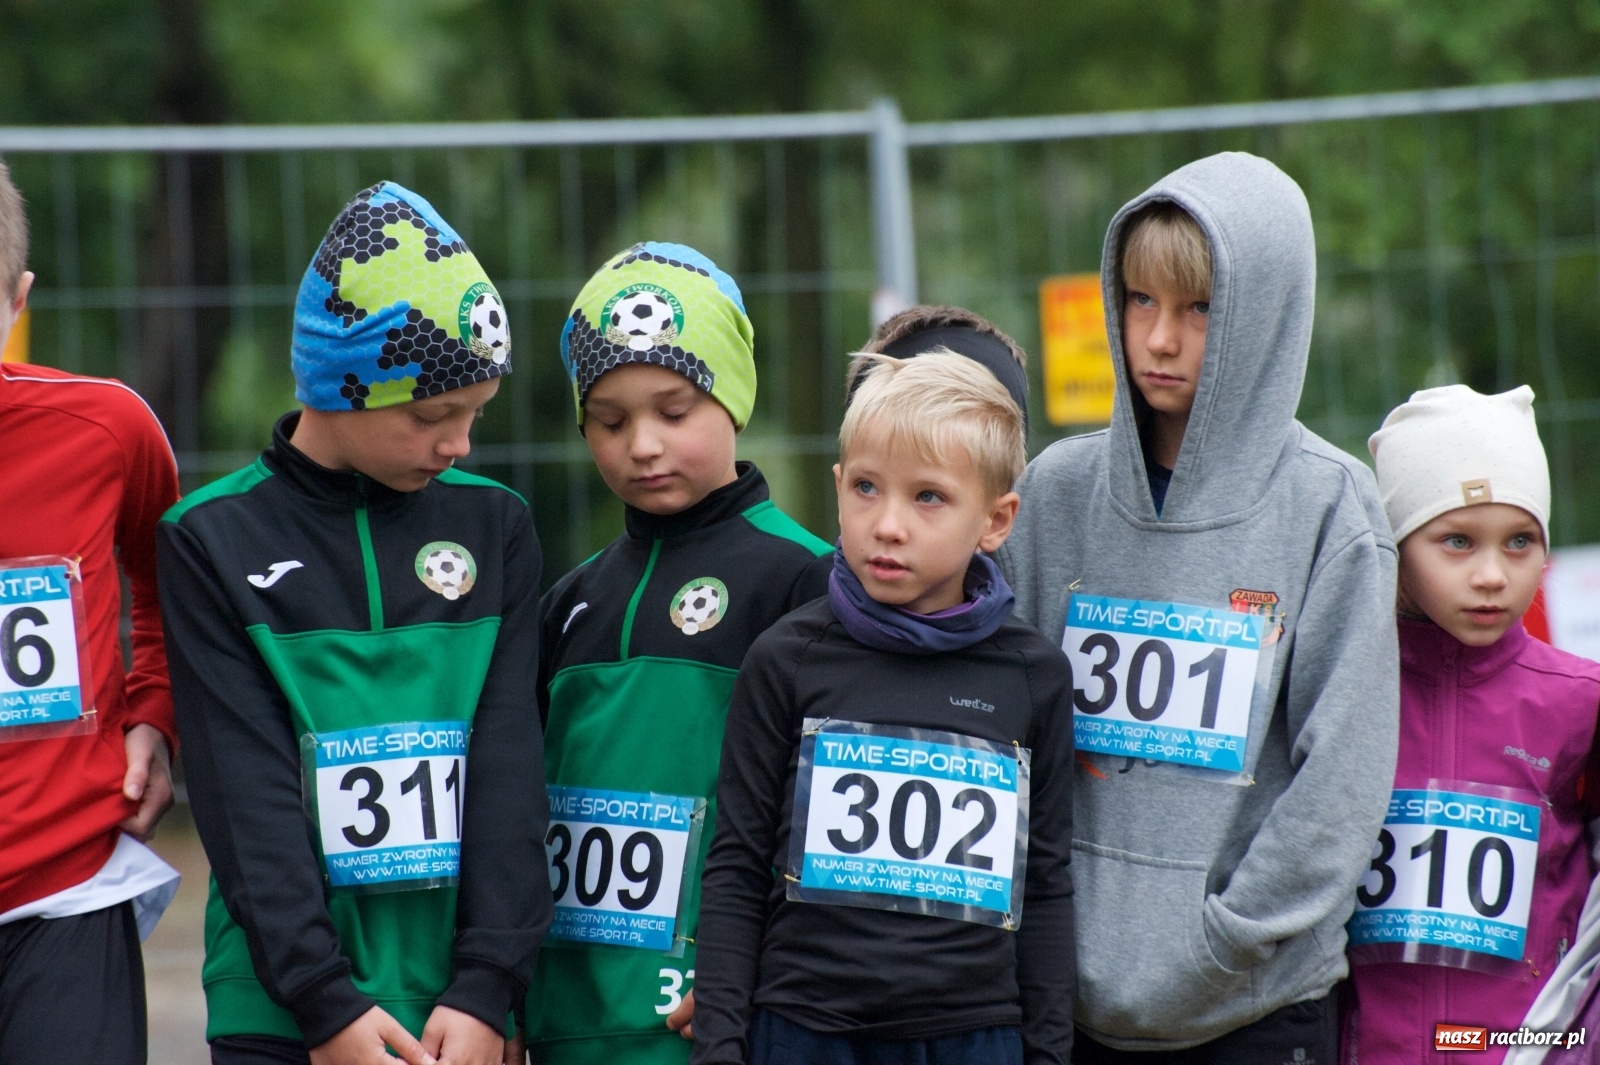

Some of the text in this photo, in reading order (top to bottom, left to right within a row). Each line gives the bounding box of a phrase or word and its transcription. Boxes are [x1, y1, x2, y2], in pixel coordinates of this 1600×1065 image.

[460, 300, 471, 324] LKS
[602, 295, 620, 316] LKS
[1236, 590, 1274, 603] ZAWADA
[1076, 602, 1257, 643] TIME-SPORT.PL
[1073, 632, 1228, 730] 301
[3, 691, 72, 707] NA MECIE
[322, 730, 466, 760] TIME-SPORT.PL
[1074, 734, 1213, 762] WWW.TIME-SPORT.PL
[1103, 723, 1170, 741] ZWROTNY
[1171, 731, 1192, 745] NA
[1194, 737, 1238, 751] MECIE
[822, 740, 1013, 785] TIME-SPORT.PL
[339, 758, 460, 849] 311
[548, 794, 684, 825] IME-SPORT.PL
[826, 772, 998, 872] 302
[333, 854, 379, 868] NUMER
[382, 847, 447, 863] ZWROTNY
[544, 822, 665, 912] 309
[812, 857, 1004, 892] NUMER ZWROTNY NA MECIE
[1356, 827, 1515, 918] 310
[833, 874, 983, 902] WWW.TIME-SPORT.PL
[559, 911, 609, 925] ZWROTNY
[610, 916, 627, 928] NA
[629, 918, 667, 932] MECIE
[1385, 913, 1459, 928] ZWROTNY
[1460, 919, 1481, 933] NA
[1483, 924, 1519, 941] MECIE
[1361, 927, 1499, 950] WWW.TIME-SPORT.PL
[653, 967, 696, 1015] 3
